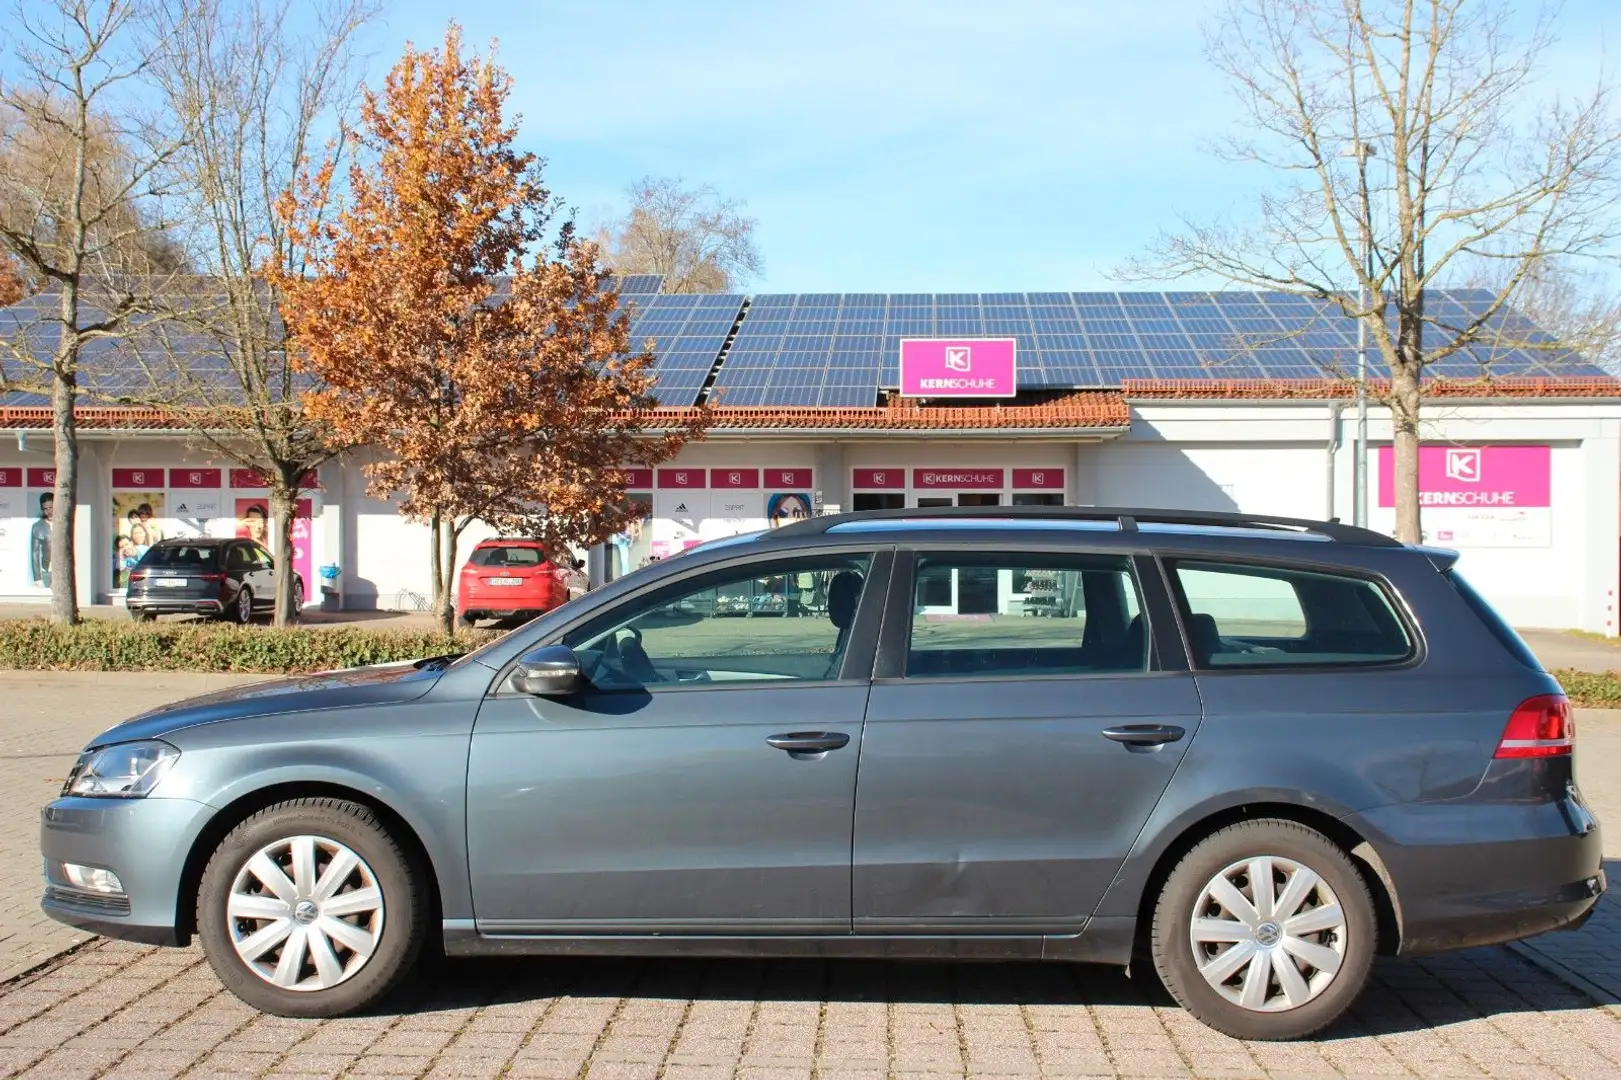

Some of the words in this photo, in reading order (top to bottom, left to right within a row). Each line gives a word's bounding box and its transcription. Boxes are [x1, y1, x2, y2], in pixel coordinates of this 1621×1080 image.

[948, 349, 968, 368] K
[920, 378, 996, 389] KERNSCHUHE
[1451, 453, 1476, 476] K
[935, 474, 995, 483] KERNSCHUHE
